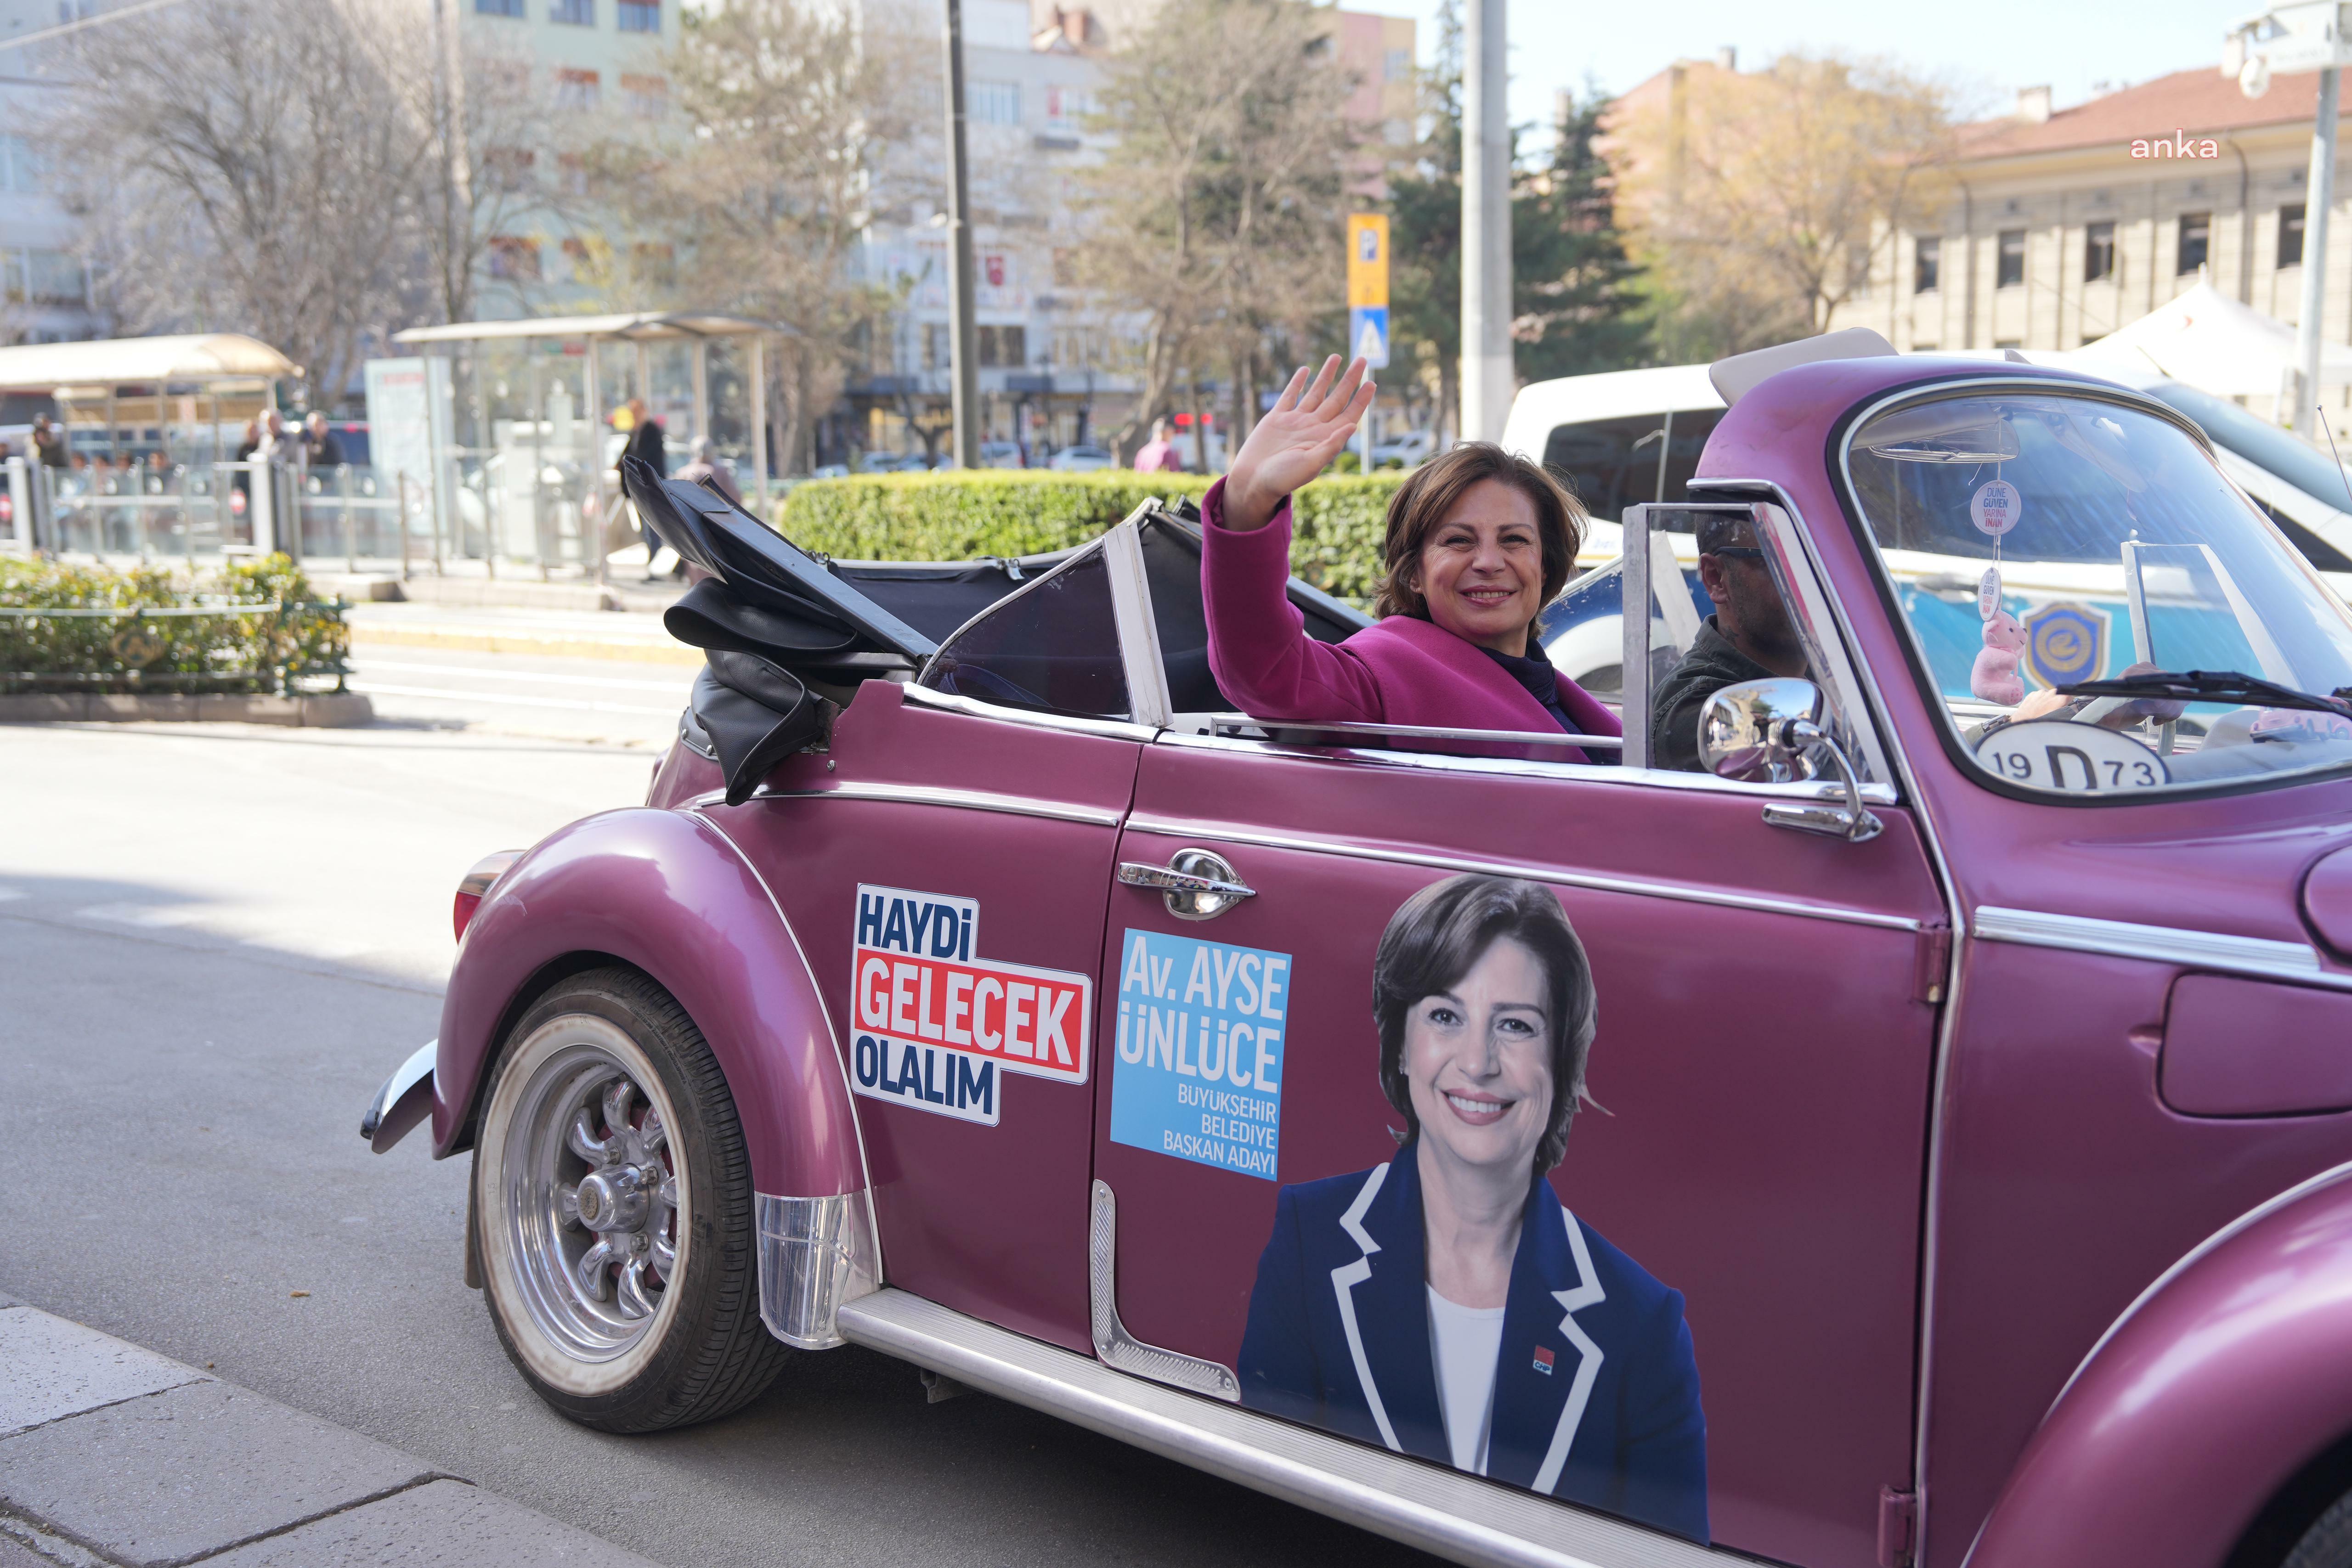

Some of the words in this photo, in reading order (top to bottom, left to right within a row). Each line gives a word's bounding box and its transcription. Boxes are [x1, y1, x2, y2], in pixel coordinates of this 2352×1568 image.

[1984, 498, 2008, 508] GÜVEN
[1984, 508, 2007, 518] YARINA
[1987, 487, 2007, 497] DÜNE
[1992, 751, 2032, 779] 19
[2045, 745, 2097, 789] D
[2103, 760, 2155, 786] 73
[1123, 936, 1176, 1001] Av.
[1183, 946, 1286, 1021] AYSE
[860, 957, 1075, 1066] GELECEK
[1119, 1000, 1280, 1094] ÜNLÜCE
[856, 1035, 994, 1115] OLALIM
[1178, 1083, 1276, 1124] BÜYÜKŞEHİR
[1164, 1129, 1224, 1162] BAŞKAN
[1227, 1145, 1275, 1175] ADAYI
[1202, 1113, 1276, 1150] BELEDİYE
